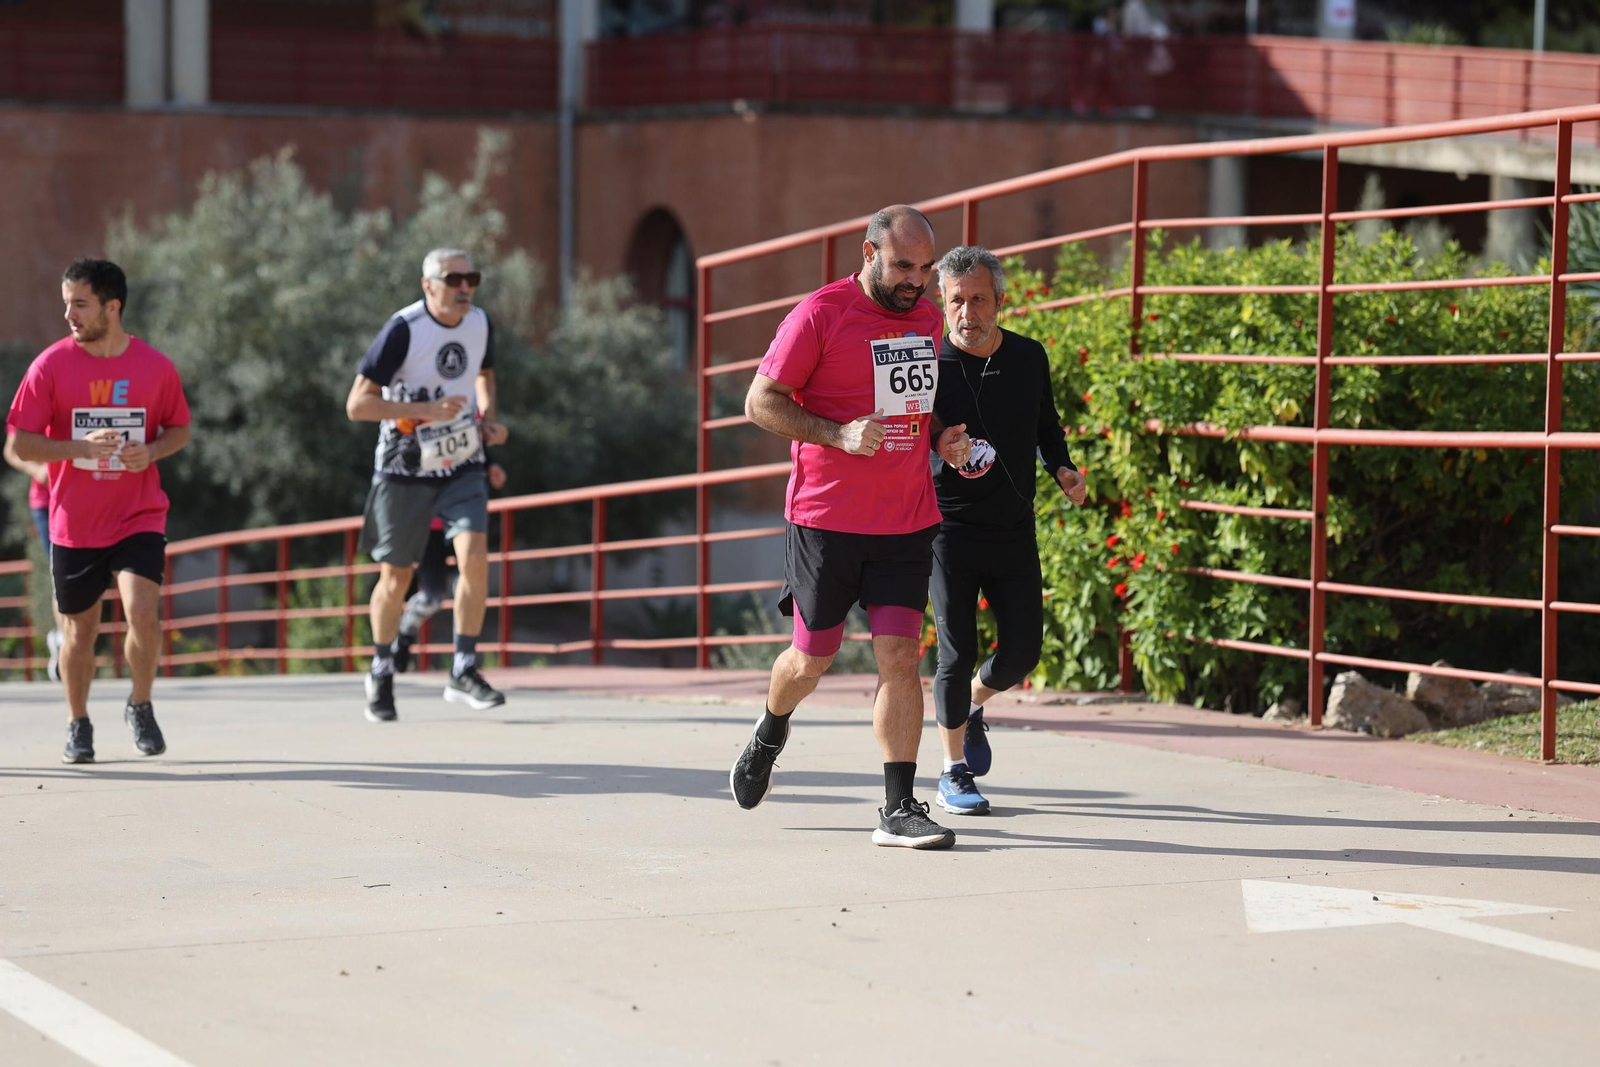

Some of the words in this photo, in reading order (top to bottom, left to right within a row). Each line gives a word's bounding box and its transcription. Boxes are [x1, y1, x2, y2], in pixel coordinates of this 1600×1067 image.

[876, 351, 910, 363] UMA
[890, 363, 934, 394] 665
[90, 379, 129, 405] WE
[906, 402, 920, 411] WE
[76, 418, 108, 428] UMA
[434, 432, 468, 459] 104
